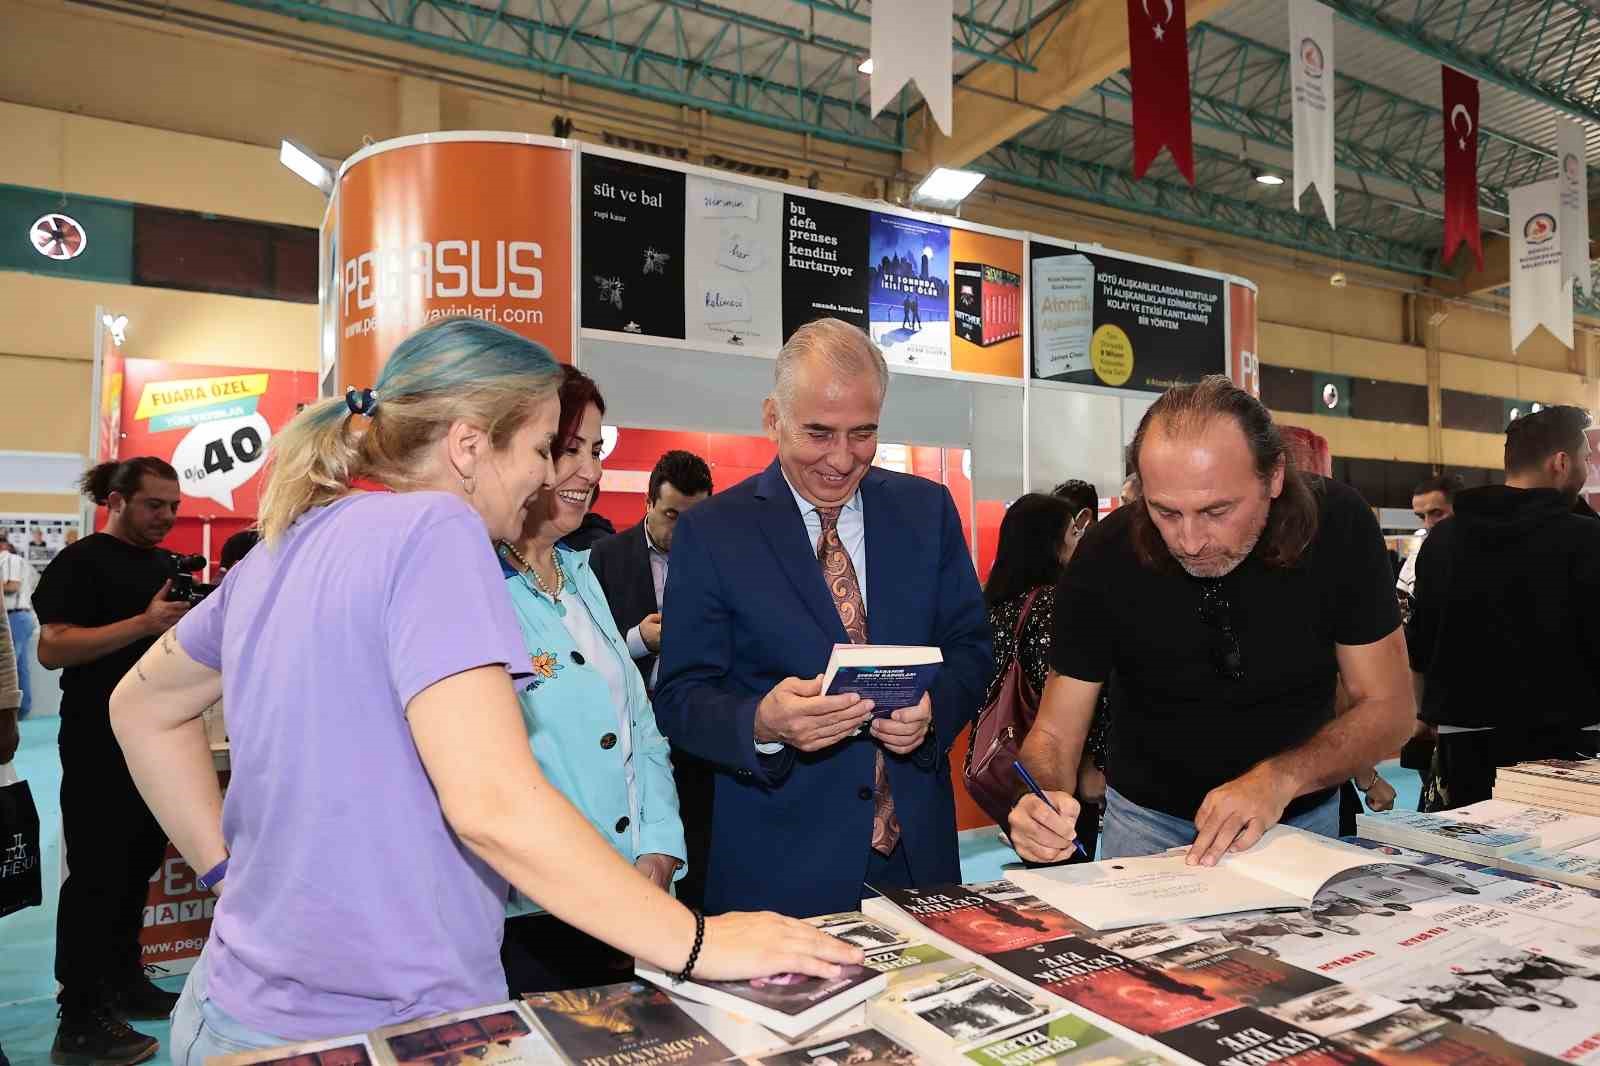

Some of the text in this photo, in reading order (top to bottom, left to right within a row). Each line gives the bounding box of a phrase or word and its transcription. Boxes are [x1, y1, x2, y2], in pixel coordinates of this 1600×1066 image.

[593, 183, 663, 208] süt ve bal
[790, 201, 806, 215] bu
[790, 216, 817, 230] defa
[789, 229, 838, 246] prenses
[789, 242, 837, 261] kendini
[789, 255, 854, 276] kurtarıyor
[1097, 272, 1117, 285] KÖTÜ
[1107, 299, 1130, 311] KOLAY
[1131, 303, 1140, 312] VE
[151, 386, 208, 407] FUARA
[1038, 951, 1088, 969] EFE
[1216, 1027, 1275, 1052] EFE
